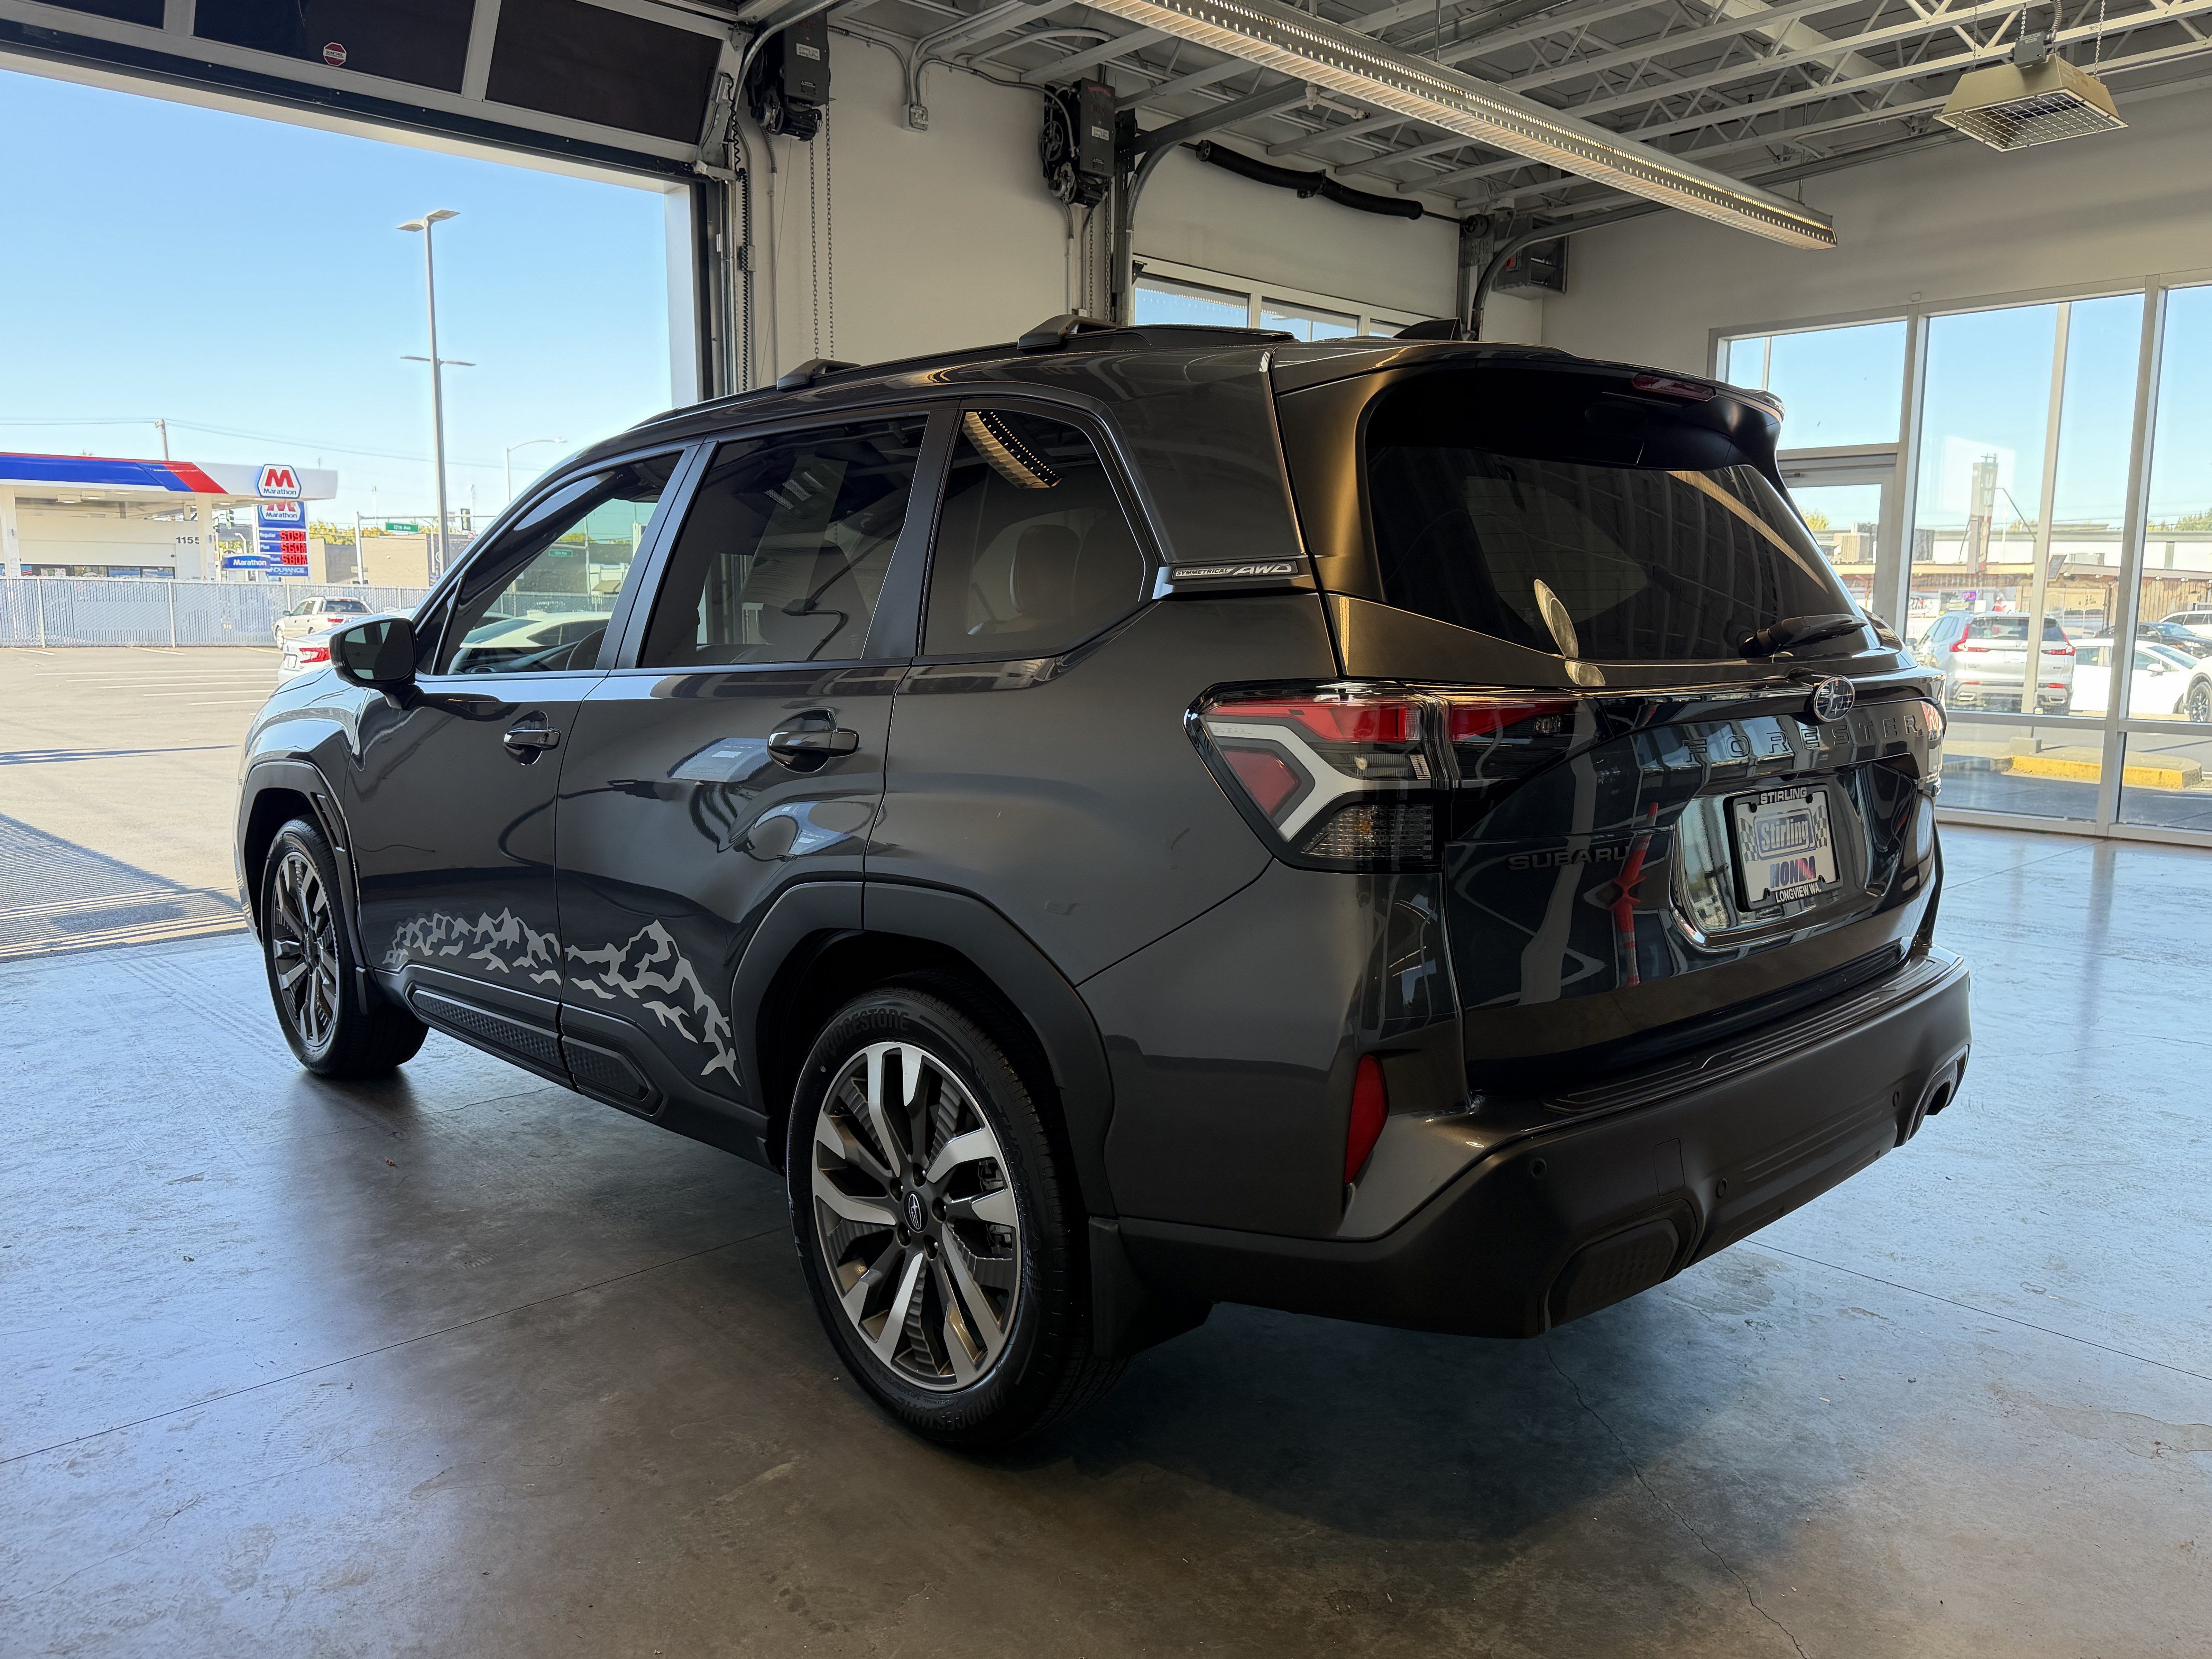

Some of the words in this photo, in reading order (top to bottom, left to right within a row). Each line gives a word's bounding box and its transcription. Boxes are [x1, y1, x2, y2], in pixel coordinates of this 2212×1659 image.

[1176, 568, 1228, 576] SYMMETRICAL
[1233, 563, 1292, 577] AWD
[1683, 715, 1924, 763] FORESTER
[1760, 787, 1807, 804] STIRLING
[1760, 819, 1809, 851] Stirling
[1508, 845, 1630, 871] SUBARU
[1770, 856, 1817, 889] HONDA
[1775, 885, 1809, 904] LONGVIEW
